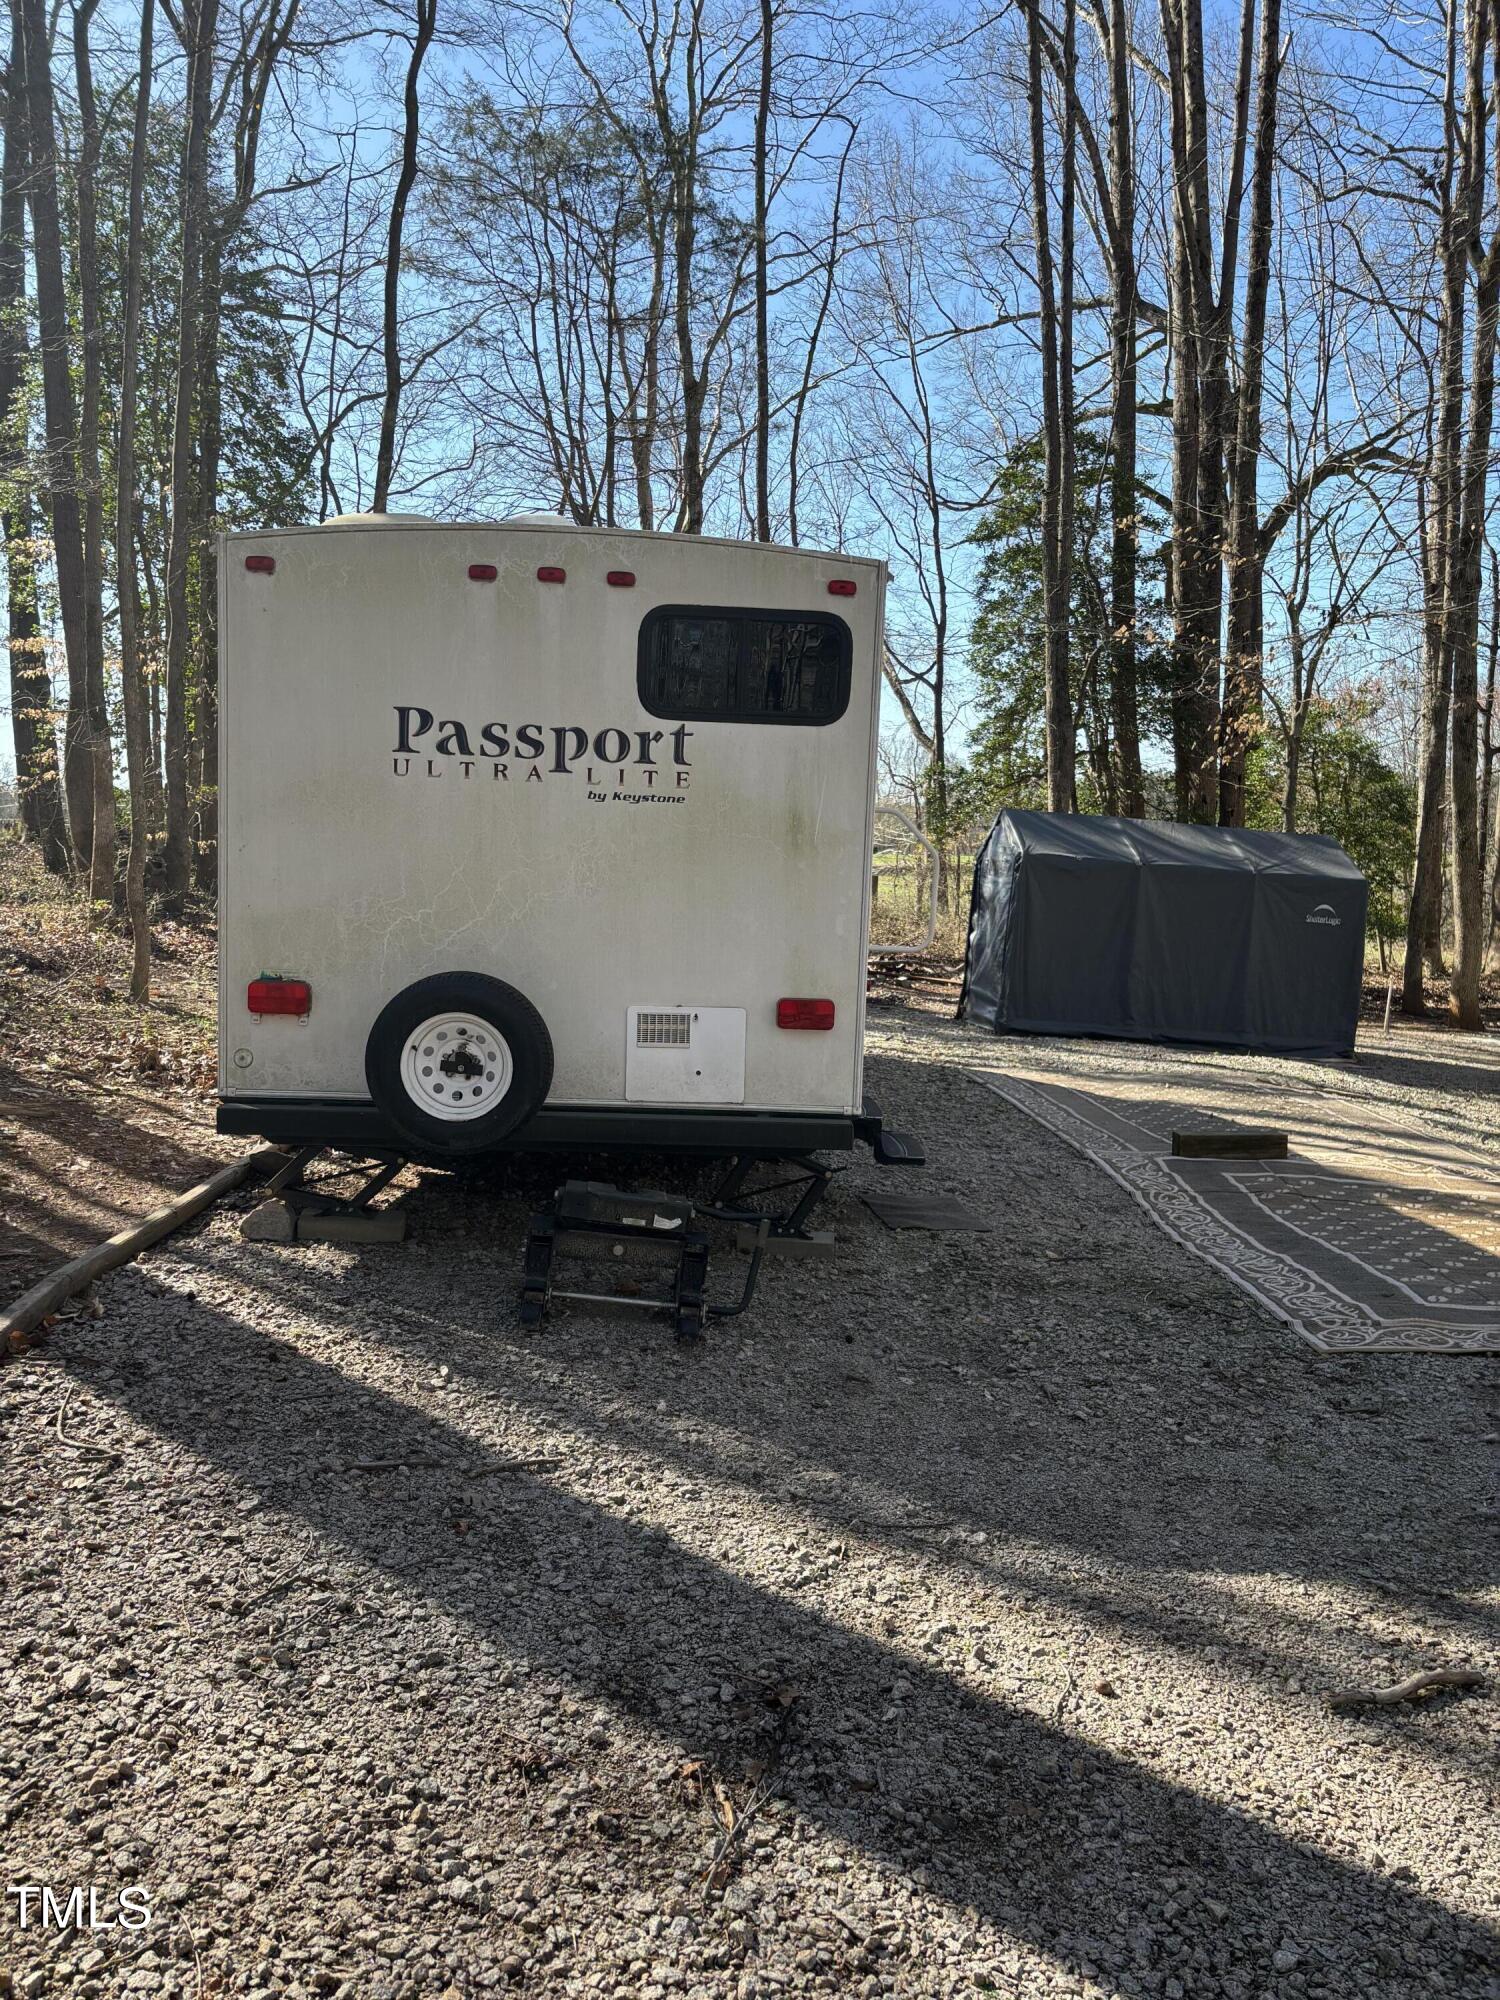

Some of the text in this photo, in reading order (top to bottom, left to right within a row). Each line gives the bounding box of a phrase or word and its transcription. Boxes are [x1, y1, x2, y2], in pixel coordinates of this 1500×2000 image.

[392, 706, 694, 773] Passport
[393, 758, 691, 789] ULTRA LITE
[587, 790, 686, 804] by Keystone
